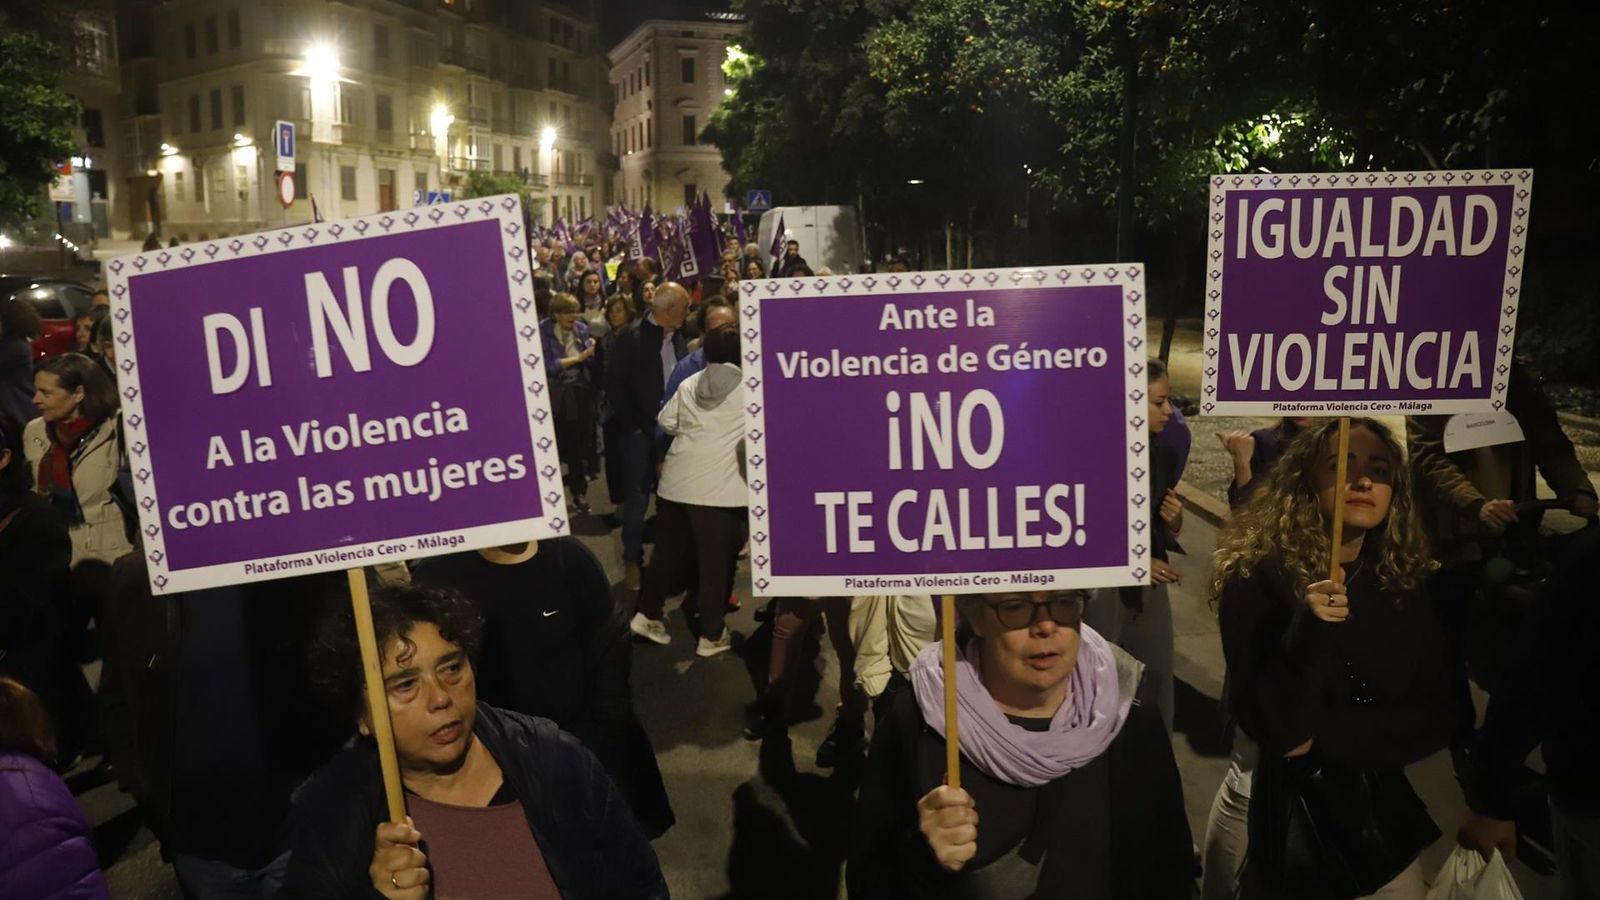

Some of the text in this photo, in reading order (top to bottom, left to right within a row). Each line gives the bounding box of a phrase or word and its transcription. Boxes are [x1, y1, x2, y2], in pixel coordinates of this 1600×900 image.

[1236, 194, 1498, 260] IGUALDAD
[202, 257, 435, 395] DI NO
[879, 298, 995, 331] Ante la
[1320, 264, 1402, 326] SIN
[776, 341, 1108, 379] Violencia de Género
[1227, 331, 1482, 392] VIOLENCIA
[206, 401, 469, 470] A la Violencia
[886, 388, 1005, 471] ¡NO
[1273, 403, 1324, 411] Plataforma
[1326, 403, 1368, 411] Violencia
[1370, 402, 1391, 411] Cero
[1399, 402, 1432, 410] Málaga
[168, 453, 527, 530] contra las mujeres
[814, 483, 1087, 554] TE CALLES!
[244, 557, 313, 575] Plataforma
[314, 548, 374, 564] Violencia
[377, 544, 407, 555] Cero
[417, 534, 465, 549] Málaga
[845, 577, 911, 589] Plataforma
[914, 576, 970, 588] Violencia
[973, 575, 1000, 586] Cero
[1011, 573, 1055, 584] Málaga
